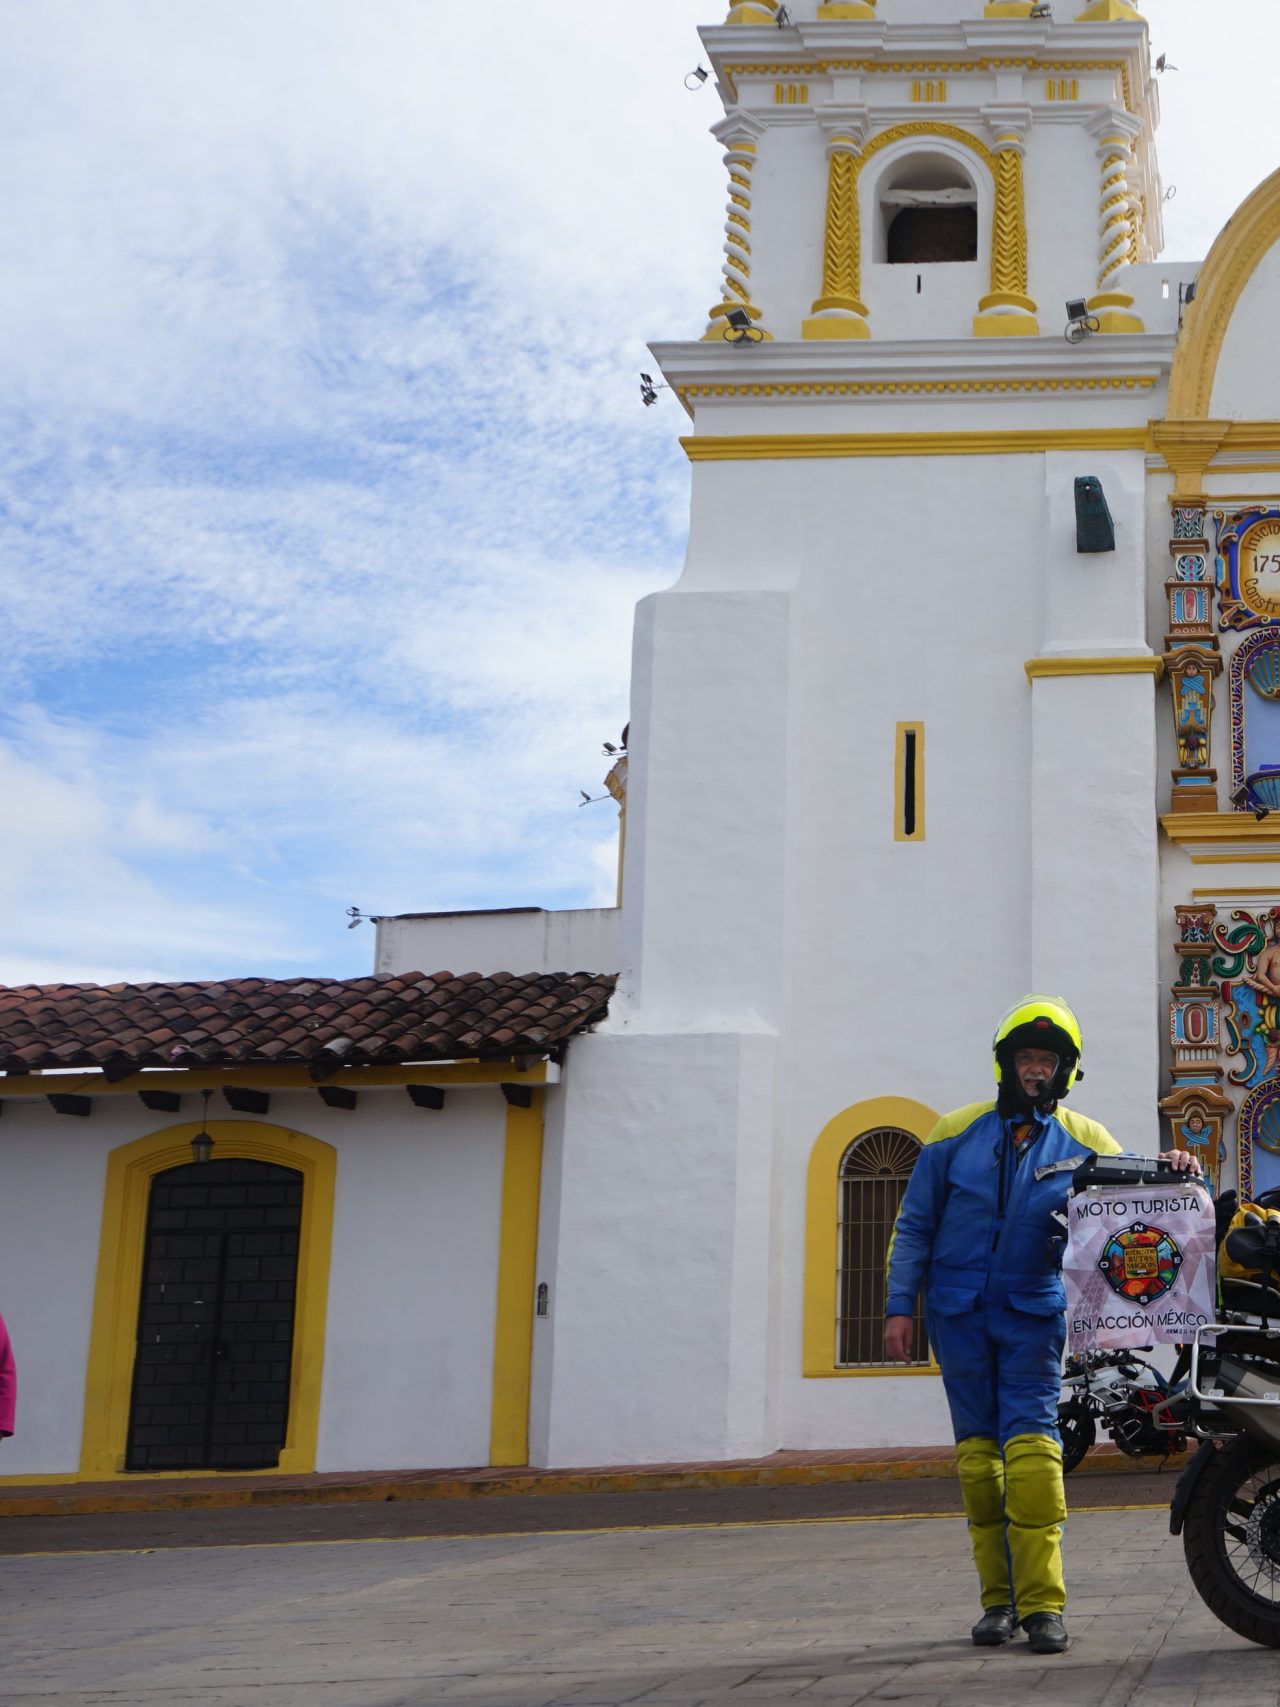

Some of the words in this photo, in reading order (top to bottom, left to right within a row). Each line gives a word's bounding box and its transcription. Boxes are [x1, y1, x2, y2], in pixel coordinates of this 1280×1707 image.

[1243, 521, 1280, 552] Inicio
[1077, 1201, 1127, 1221] MOTO
[1131, 1197, 1200, 1215] TURISTA
[1100, 1261, 1110, 1269] O
[1174, 1256, 1181, 1264] E
[1139, 1295, 1148, 1303] S
[1073, 1318, 1092, 1334] EN
[1096, 1311, 1154, 1330] ACCIÓN
[1157, 1308, 1208, 1327] MÉXICO
